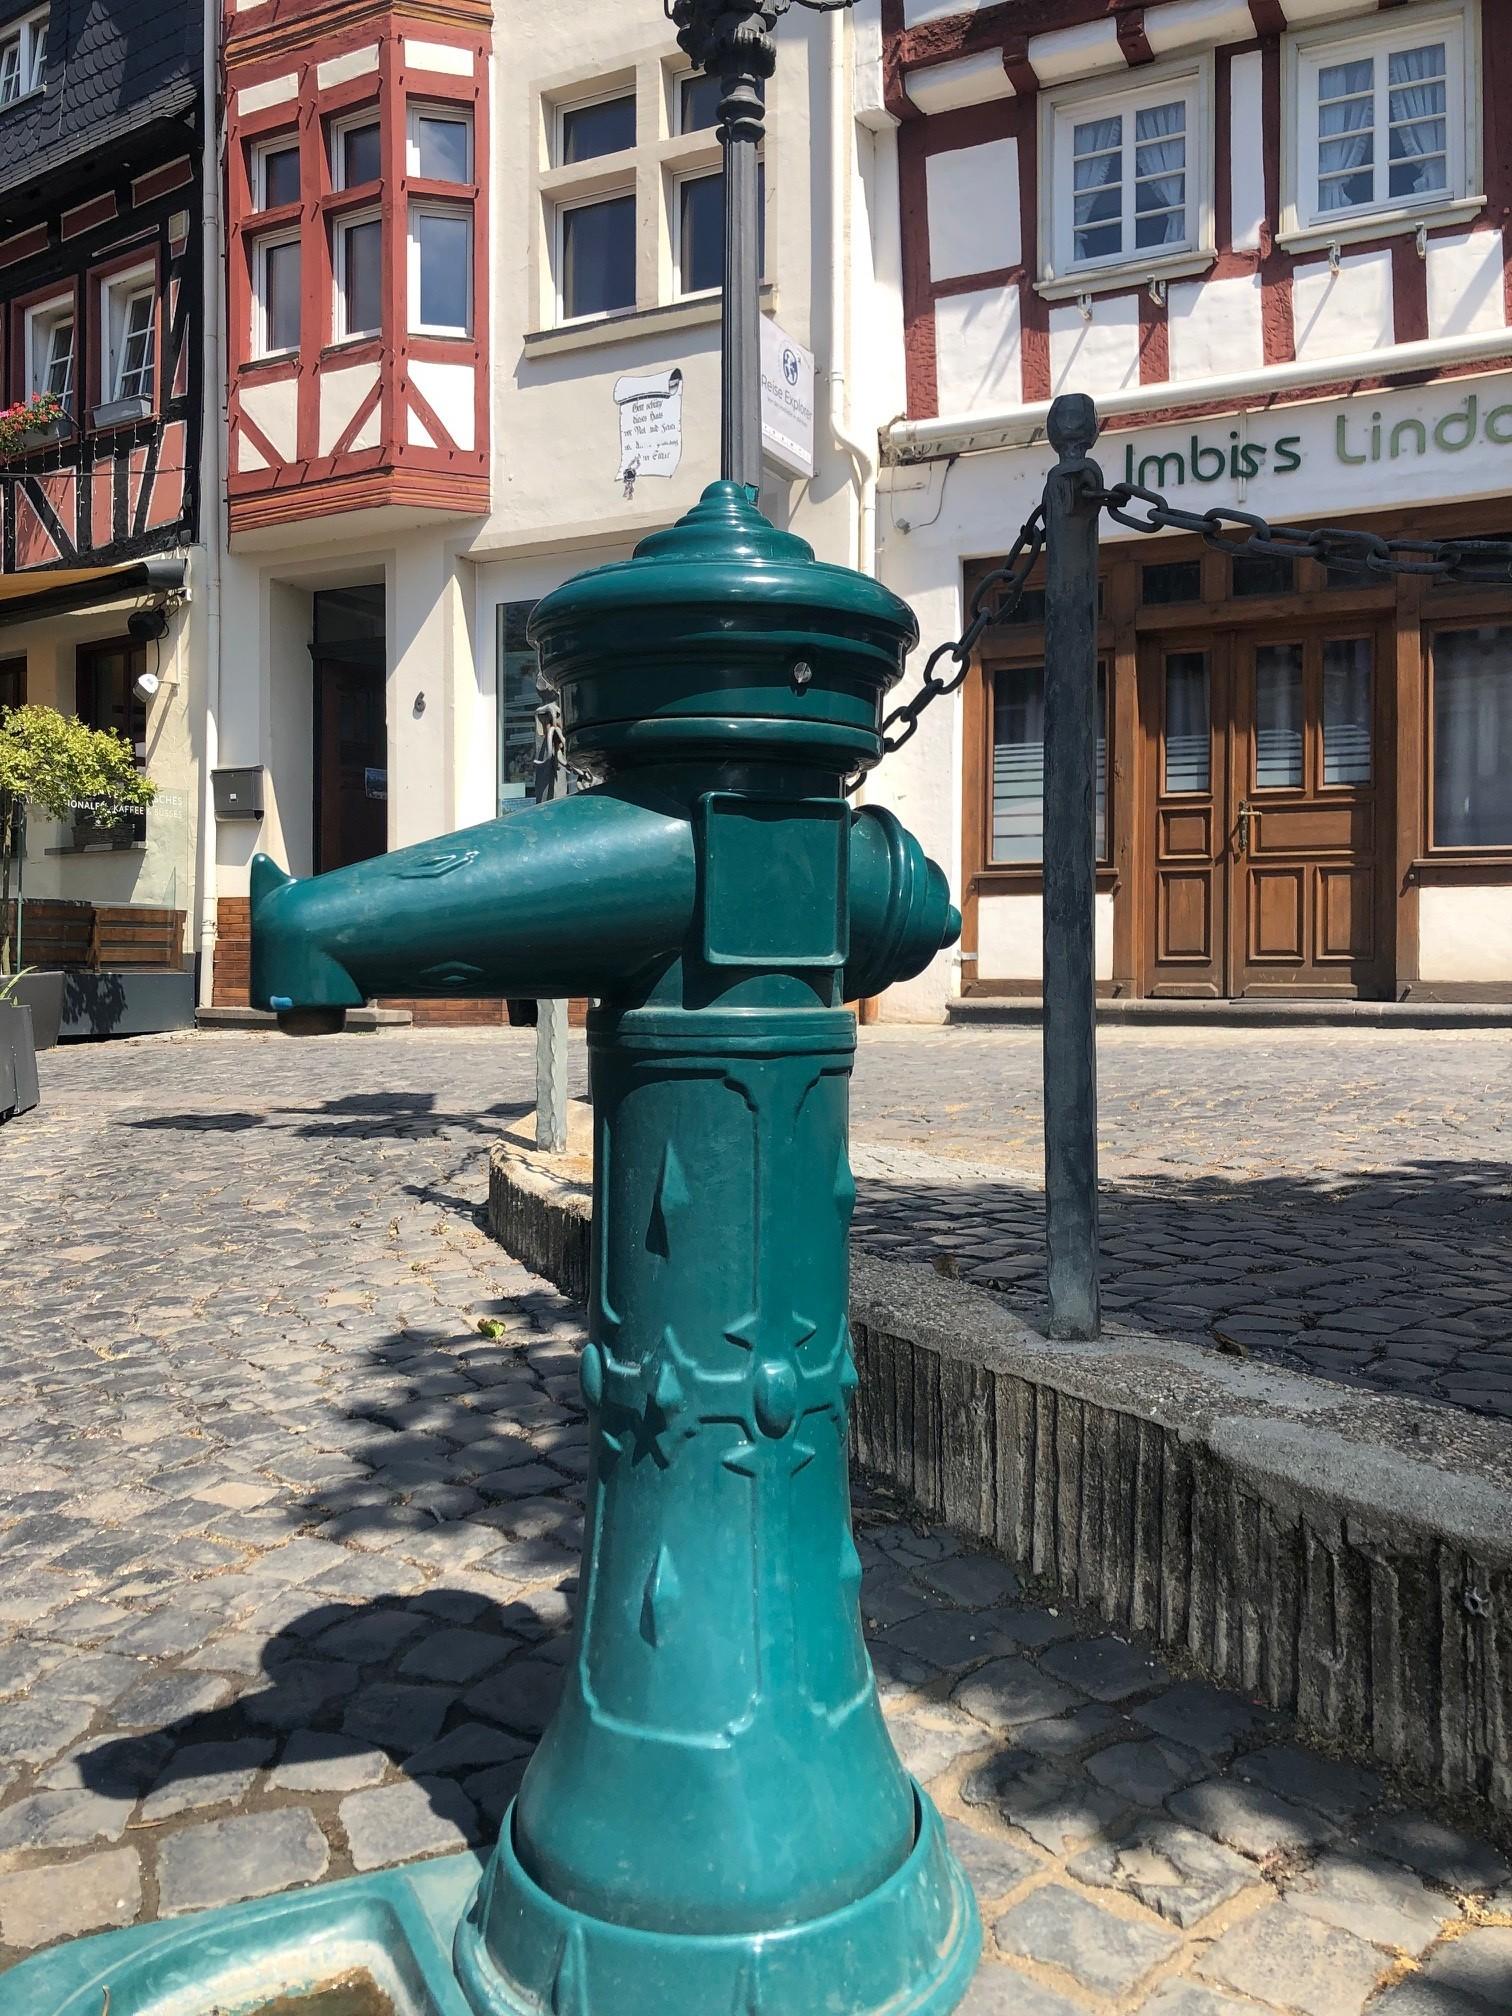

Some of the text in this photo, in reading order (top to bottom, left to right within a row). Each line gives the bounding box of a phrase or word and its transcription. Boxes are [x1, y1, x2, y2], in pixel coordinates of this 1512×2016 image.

[761, 374, 783, 400] Reise
[784, 389, 813, 421] Explorer
[1125, 430, 1302, 487] Imbiss
[113, 804, 145, 815] KAFFEE
